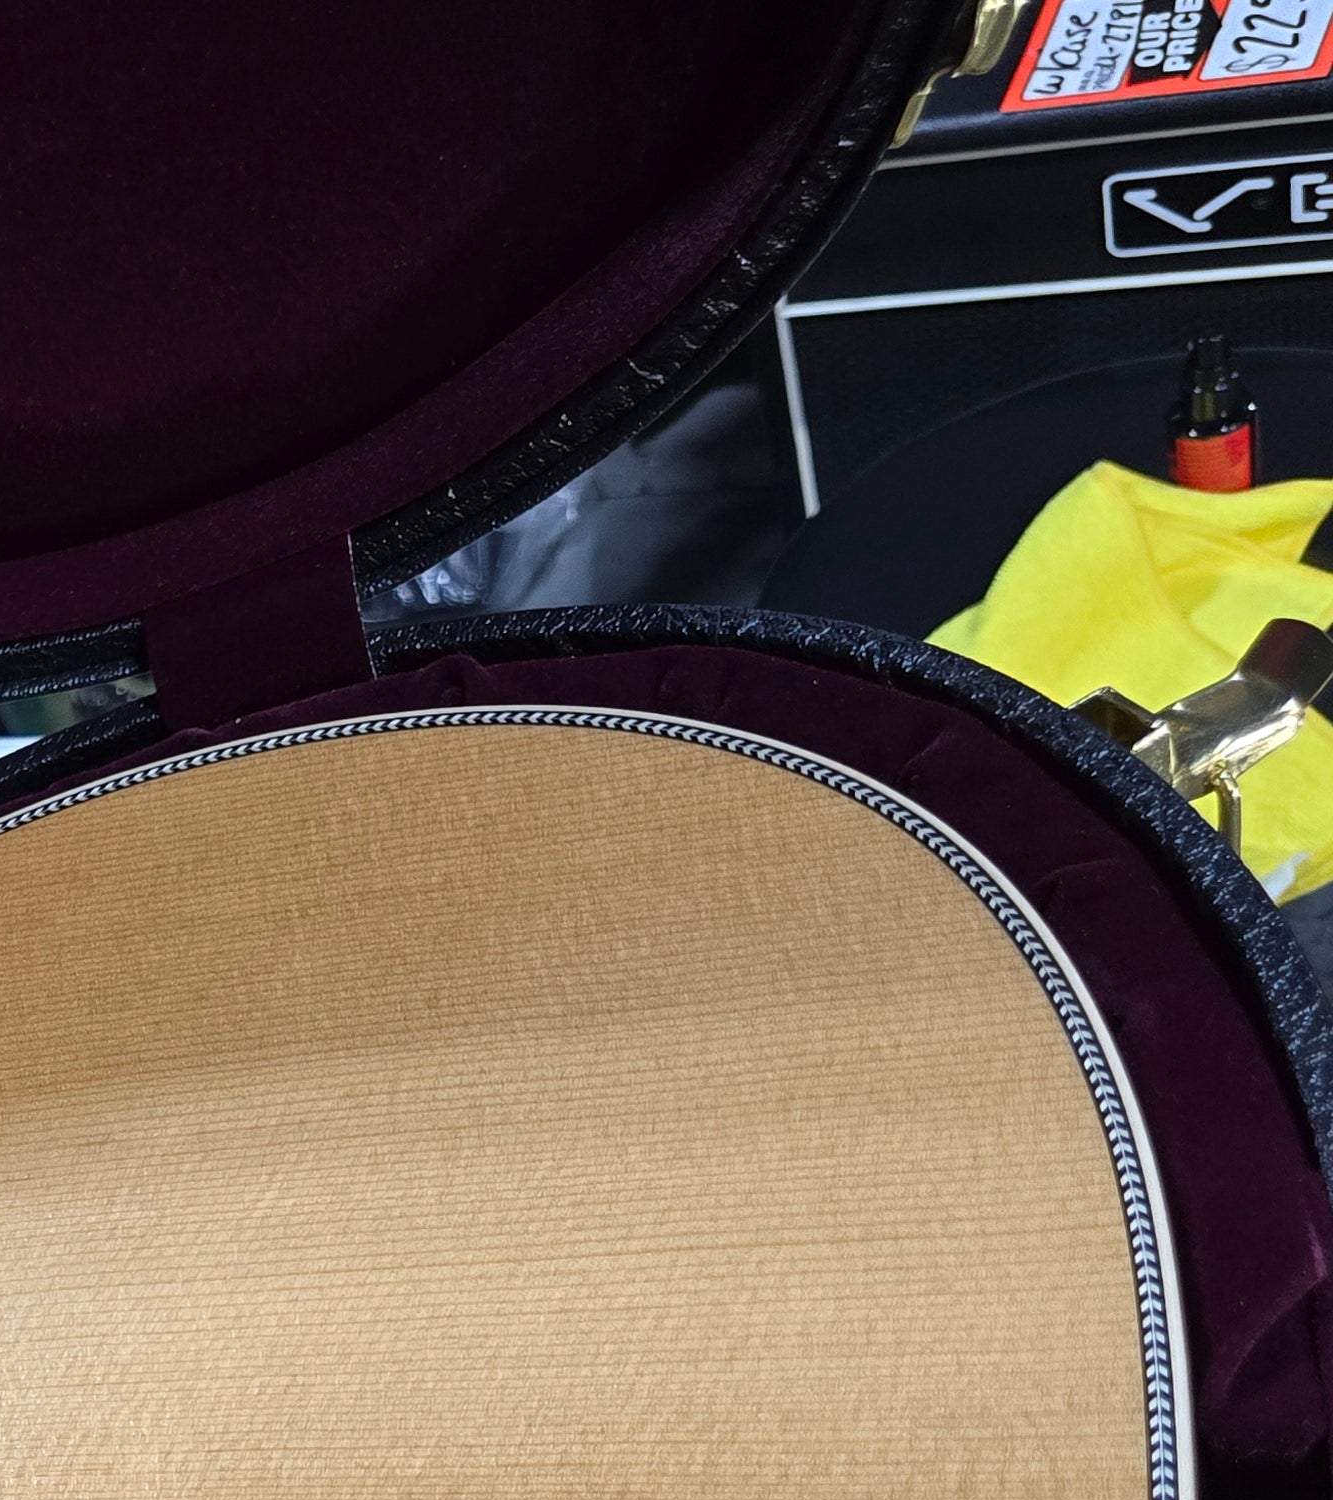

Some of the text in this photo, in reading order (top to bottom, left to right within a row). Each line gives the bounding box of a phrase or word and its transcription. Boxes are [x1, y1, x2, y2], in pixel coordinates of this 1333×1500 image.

[1134, 12, 1172, 68] OUR
[1162, 0, 1204, 73] PRICE
[1220, 0, 1307, 73] $22
